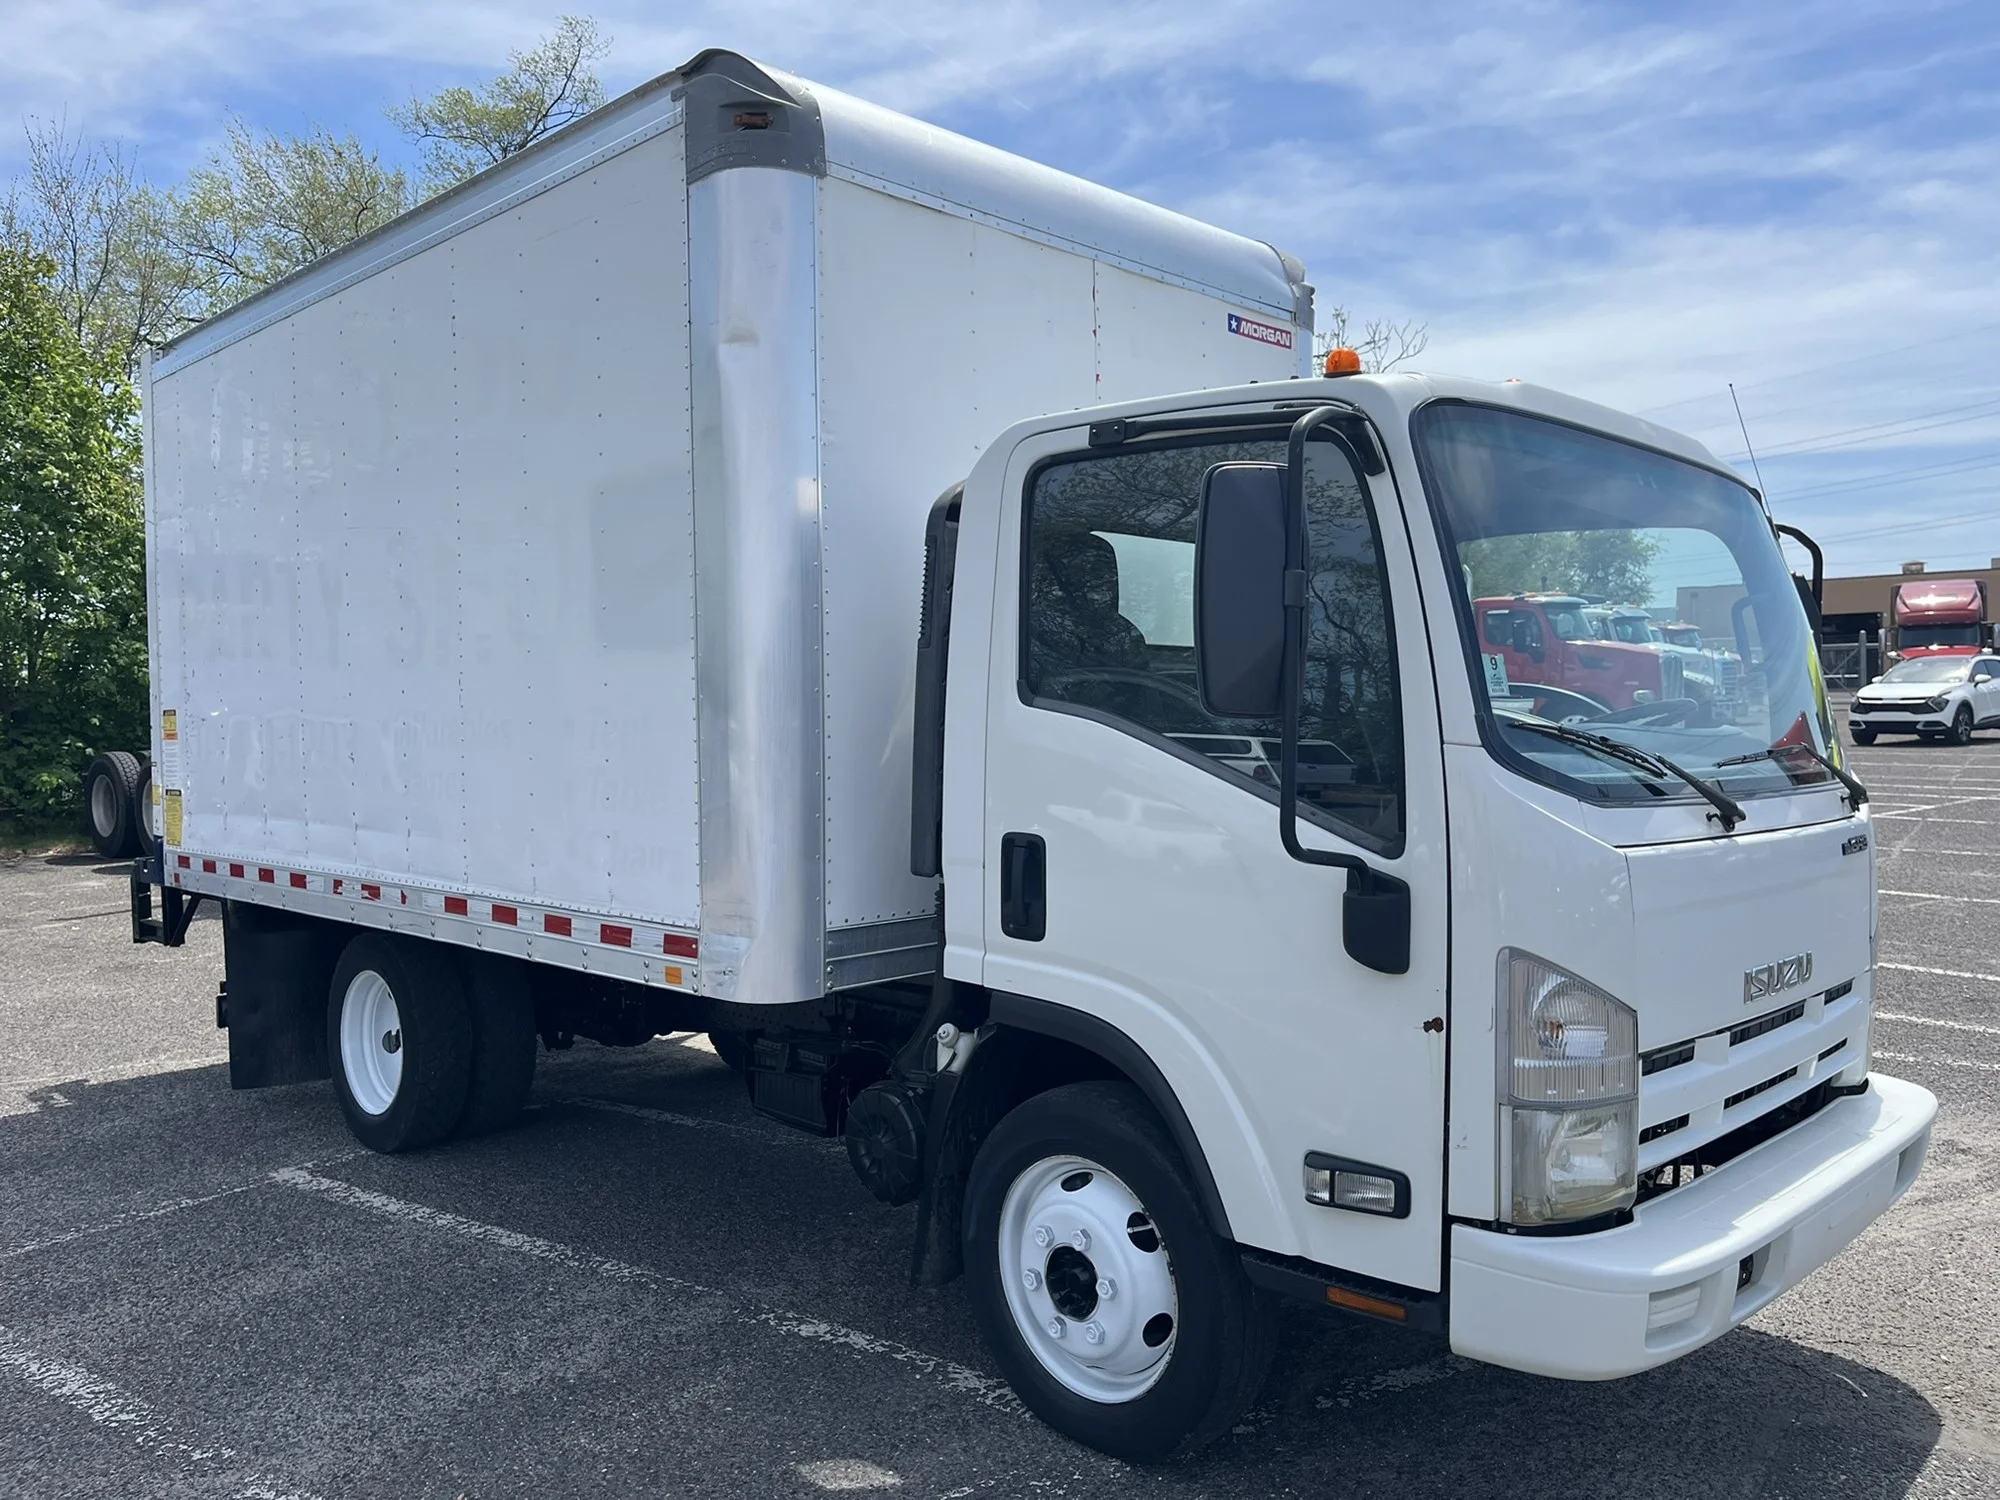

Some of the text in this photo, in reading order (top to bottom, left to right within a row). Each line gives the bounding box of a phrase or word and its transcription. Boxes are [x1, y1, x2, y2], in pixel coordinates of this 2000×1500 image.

[1240, 320, 1290, 347] MORGAN
[1490, 656, 1498, 671] 9
[1743, 950, 1813, 1005] ISUZU
